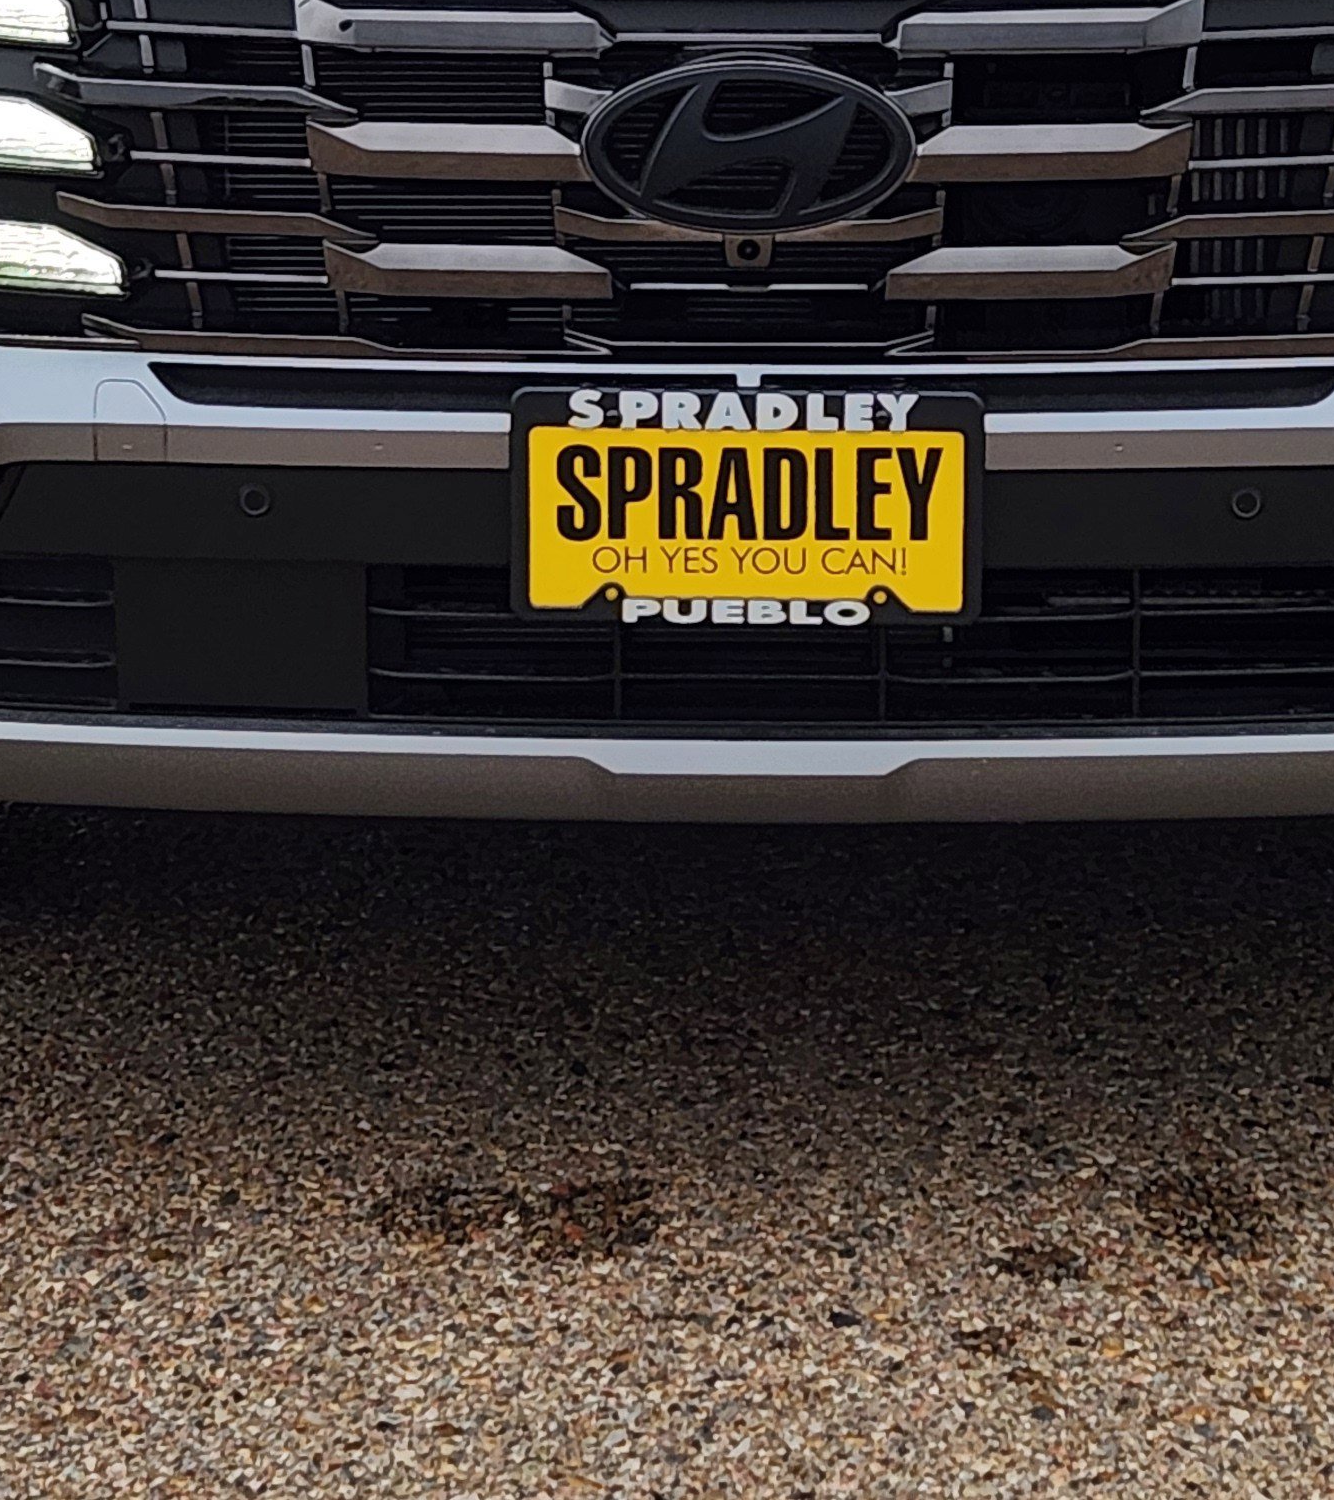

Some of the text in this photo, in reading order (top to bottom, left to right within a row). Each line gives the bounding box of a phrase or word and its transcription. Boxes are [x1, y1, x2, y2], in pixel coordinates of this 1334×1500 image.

[568, 389, 919, 432] SPRADLEY
[556, 445, 944, 541] SPRADLEY
[592, 546, 907, 575] OH YES YOU CAN!
[621, 599, 870, 626] PUEBLO
